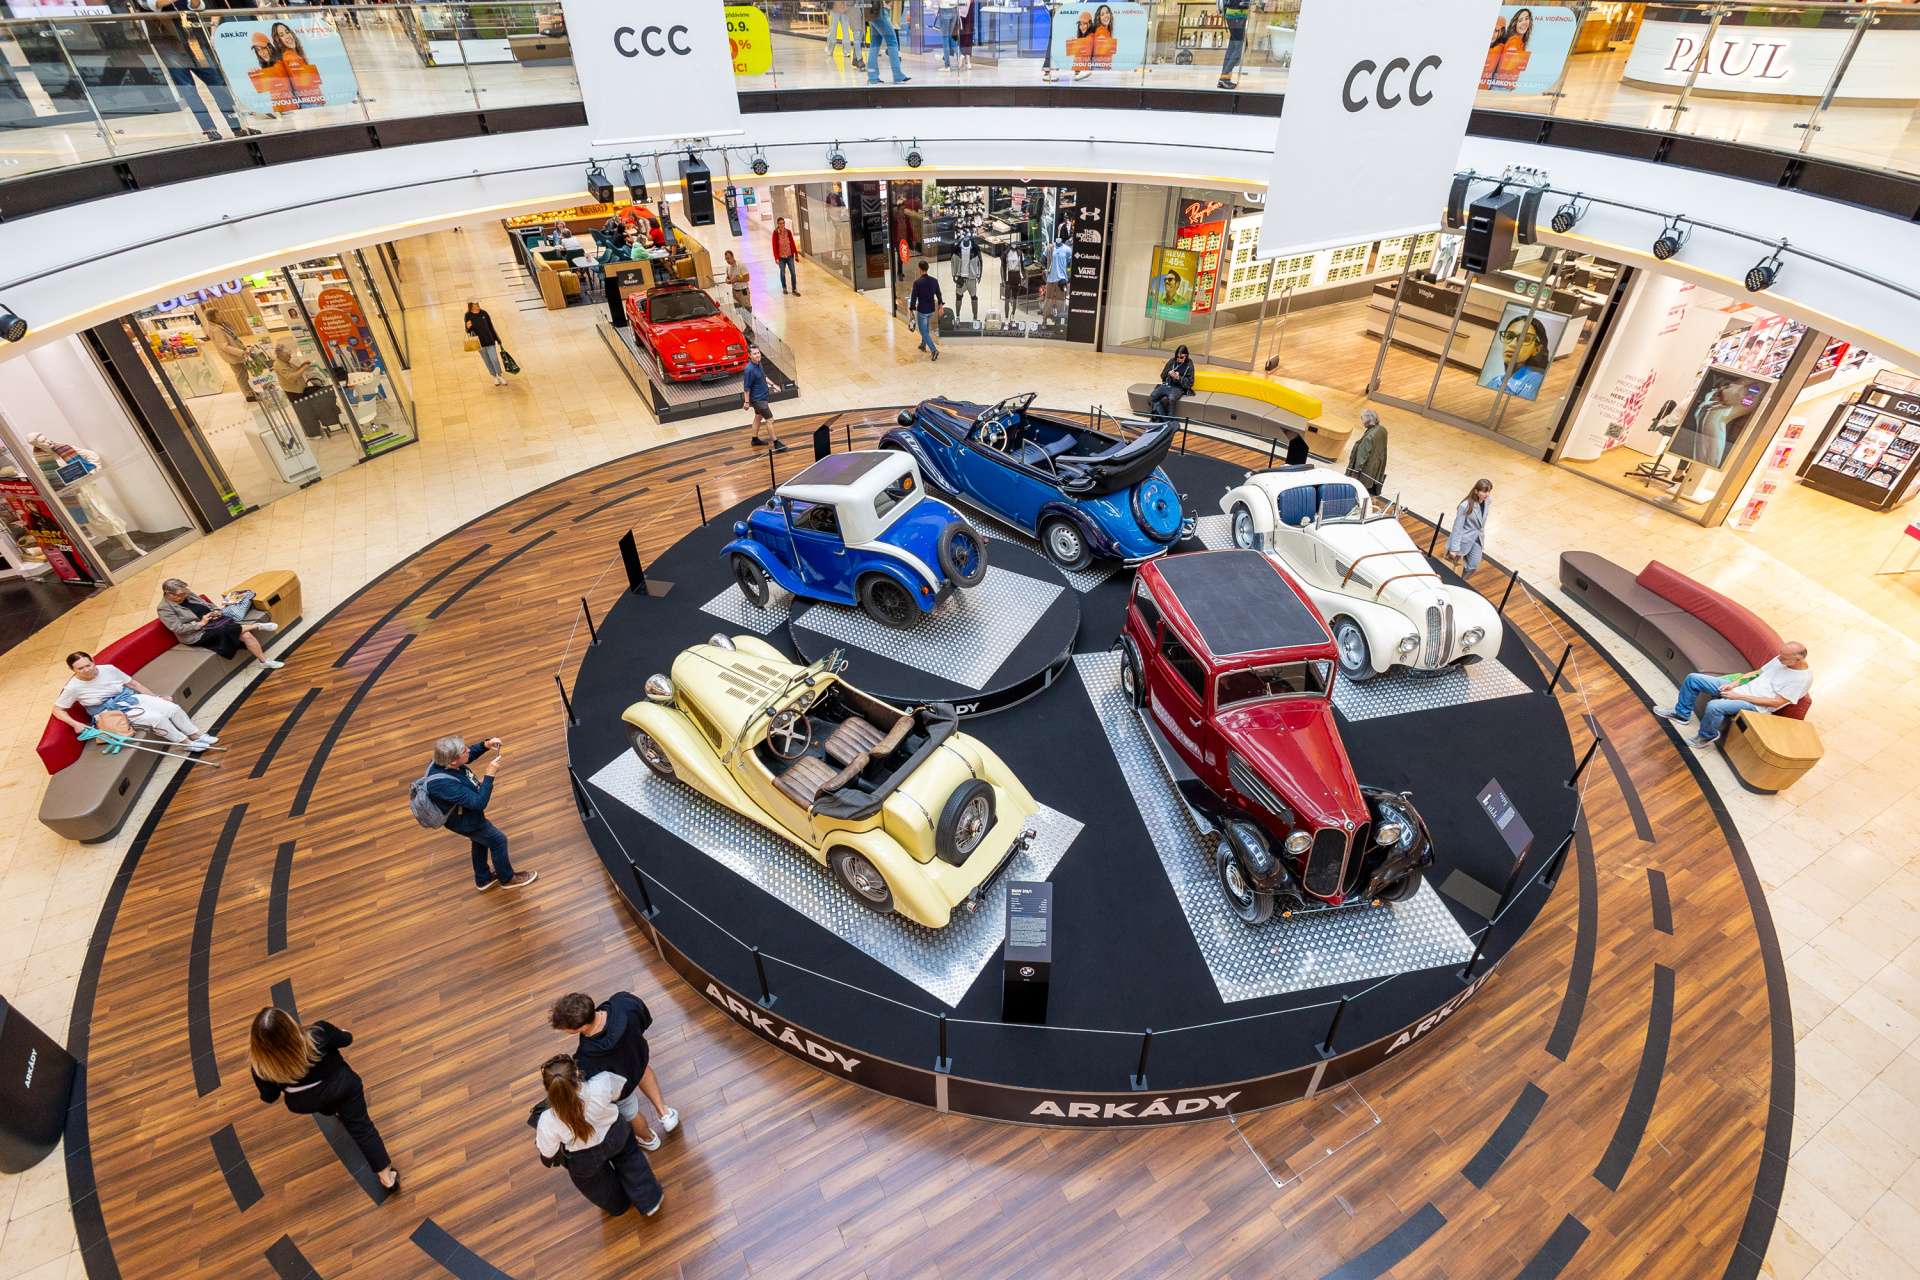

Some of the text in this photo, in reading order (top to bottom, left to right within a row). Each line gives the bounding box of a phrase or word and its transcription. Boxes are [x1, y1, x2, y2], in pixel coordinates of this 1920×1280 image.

[614, 25, 692, 58] CCC
[1664, 37, 1790, 80] PAUL
[1342, 55, 1443, 113] CCC
[1895, 400, 1920, 414] GO
[706, 983, 861, 1072] ARKÁDY
[24, 1048, 38, 1089] ARKÁDY
[1030, 1091, 1242, 1118] ARKÁDY
